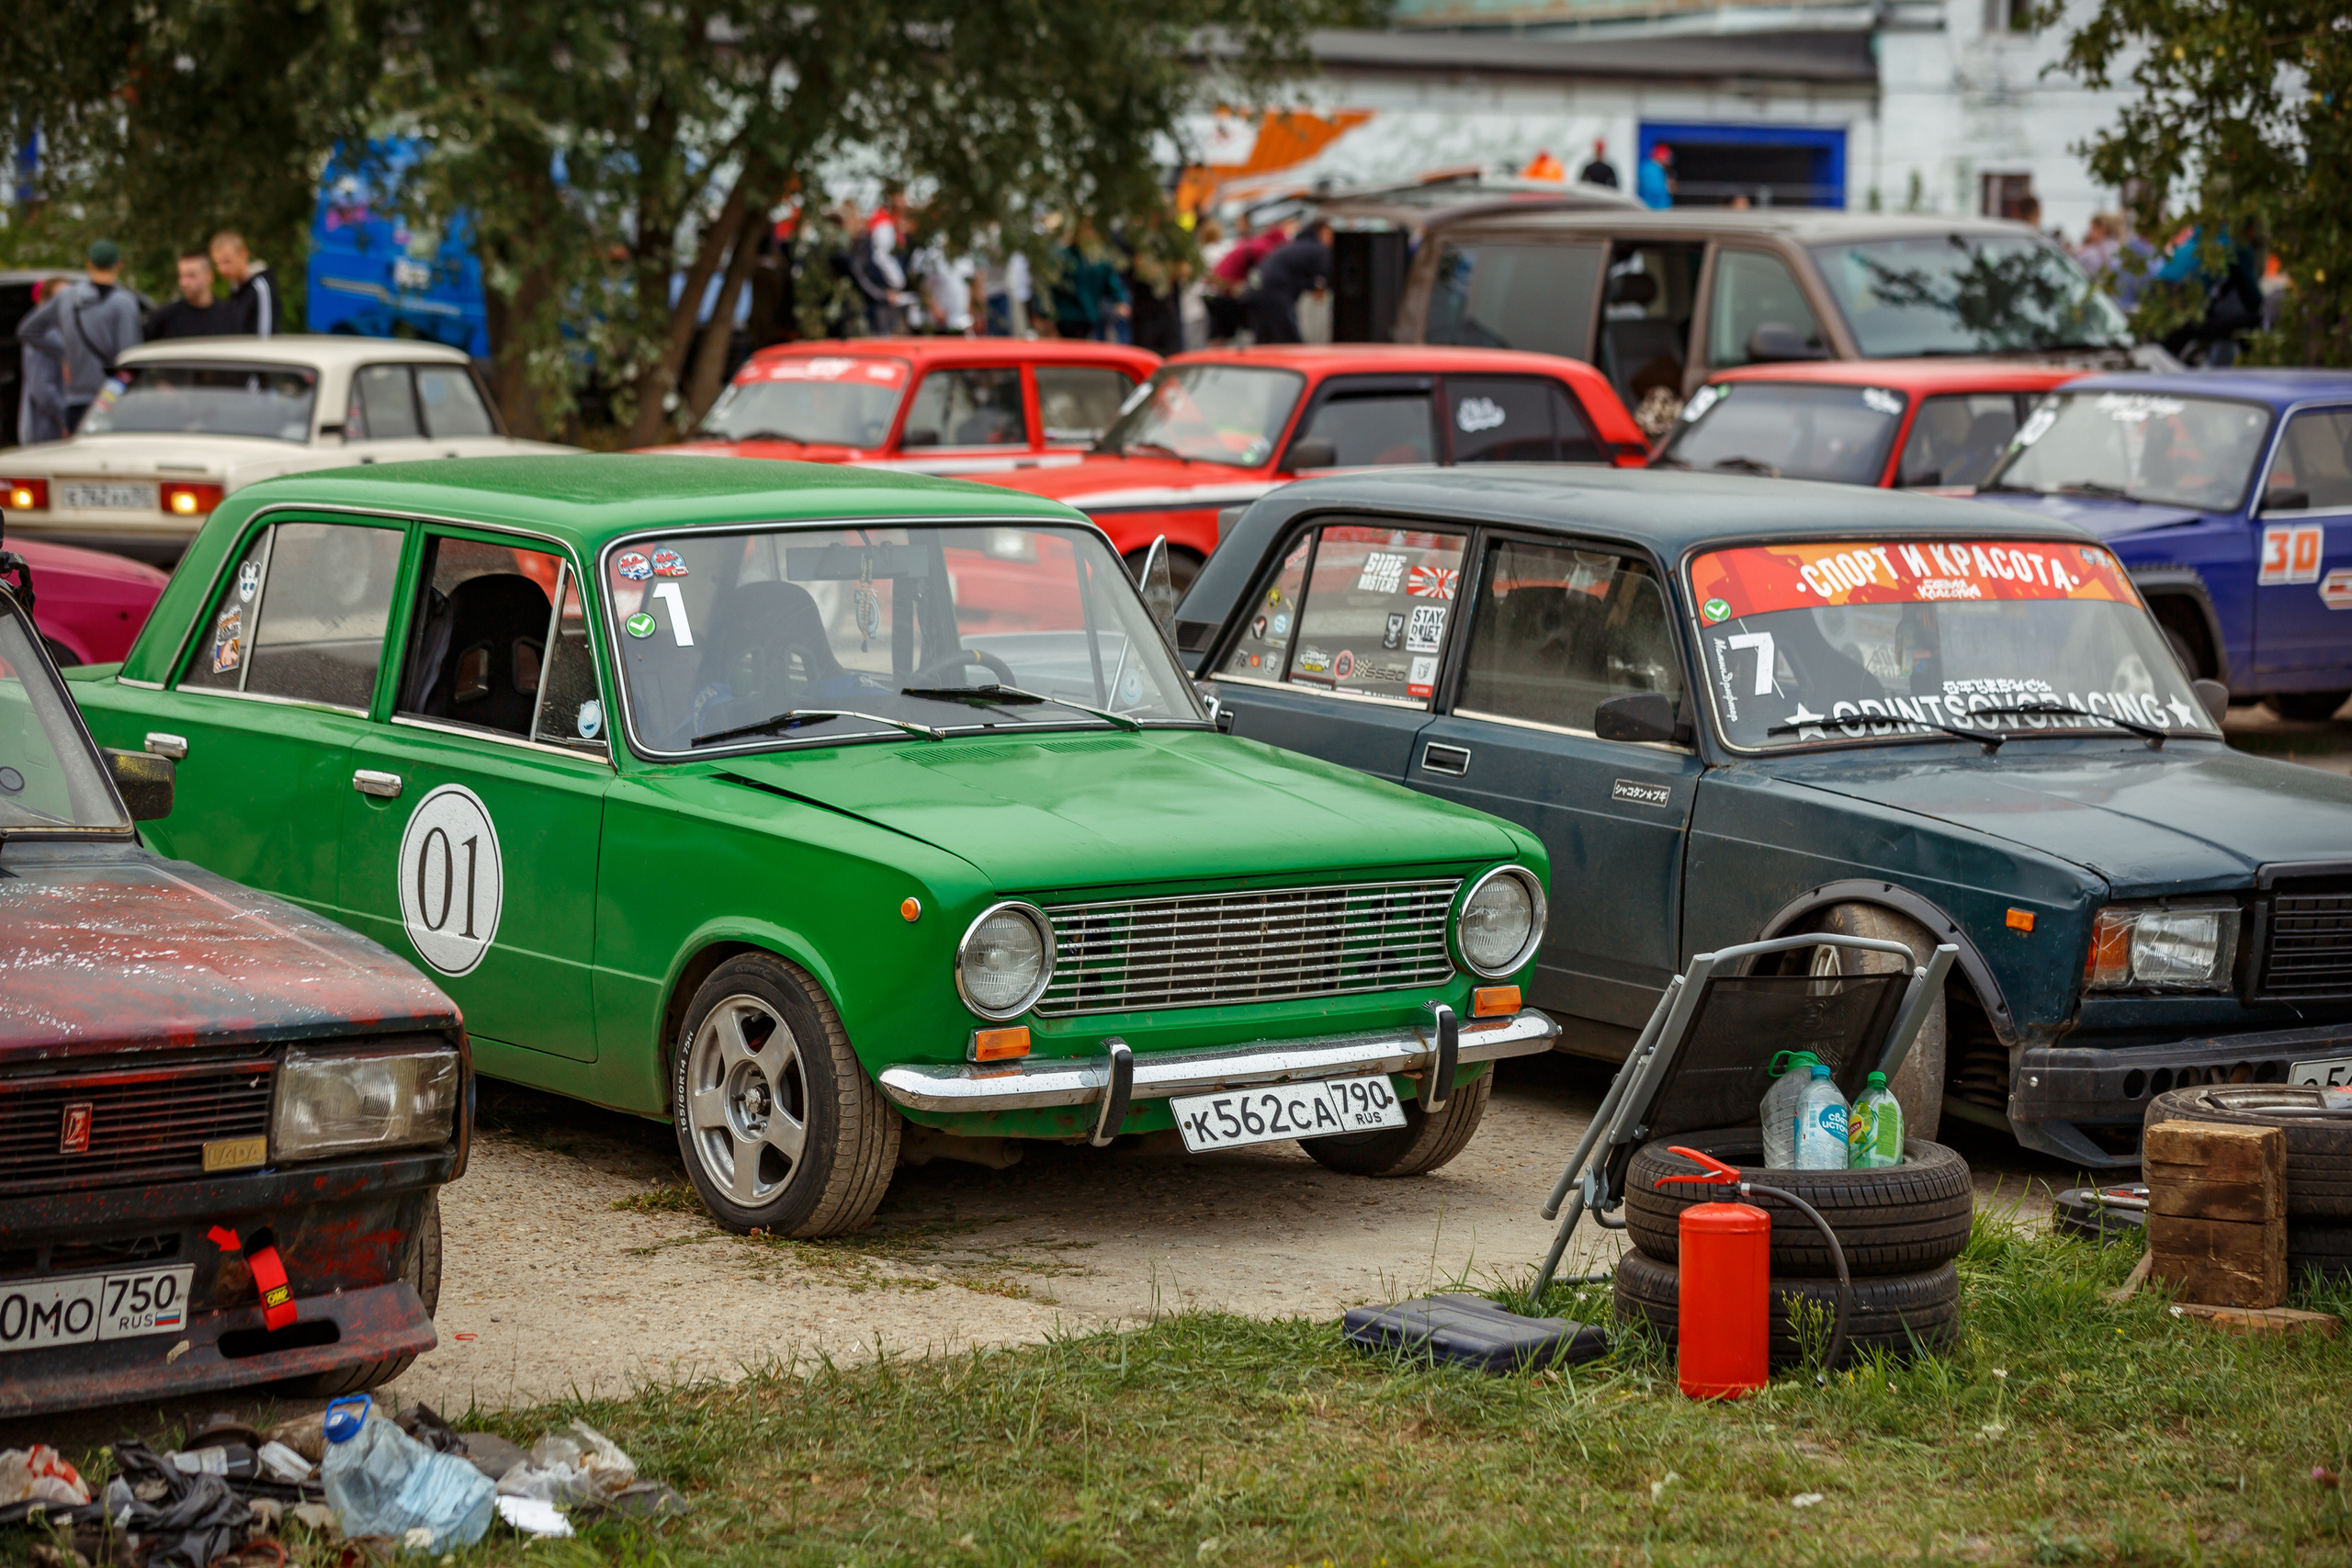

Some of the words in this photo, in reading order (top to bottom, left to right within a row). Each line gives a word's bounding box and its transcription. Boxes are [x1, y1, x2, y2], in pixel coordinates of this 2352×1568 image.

[1363, 552, 1407, 578] SIDE
[1802, 546, 1898, 598] СПОРТ
[1898, 545, 1931, 579] И
[1928, 543, 2074, 593] КРАСОТА
[2261, 526, 2322, 580] 30
[1358, 573, 1400, 594] MASTERS
[652, 582, 695, 648] 1
[1414, 609, 1443, 626] STAY
[1365, 667, 1407, 682] SS20
[1727, 631, 1775, 696] 7
[418, 827, 481, 941] 01
[678, 1060, 689, 1134] 165/60R14
[1331, 1080, 1388, 1114] 790
[1191, 1093, 1338, 1143] К562СА
[1355, 1111, 1383, 1125] RUS
[208, 1143, 263, 1167] LADA
[107, 1274, 176, 1318] 750
[119, 1313, 153, 1332] RUS
